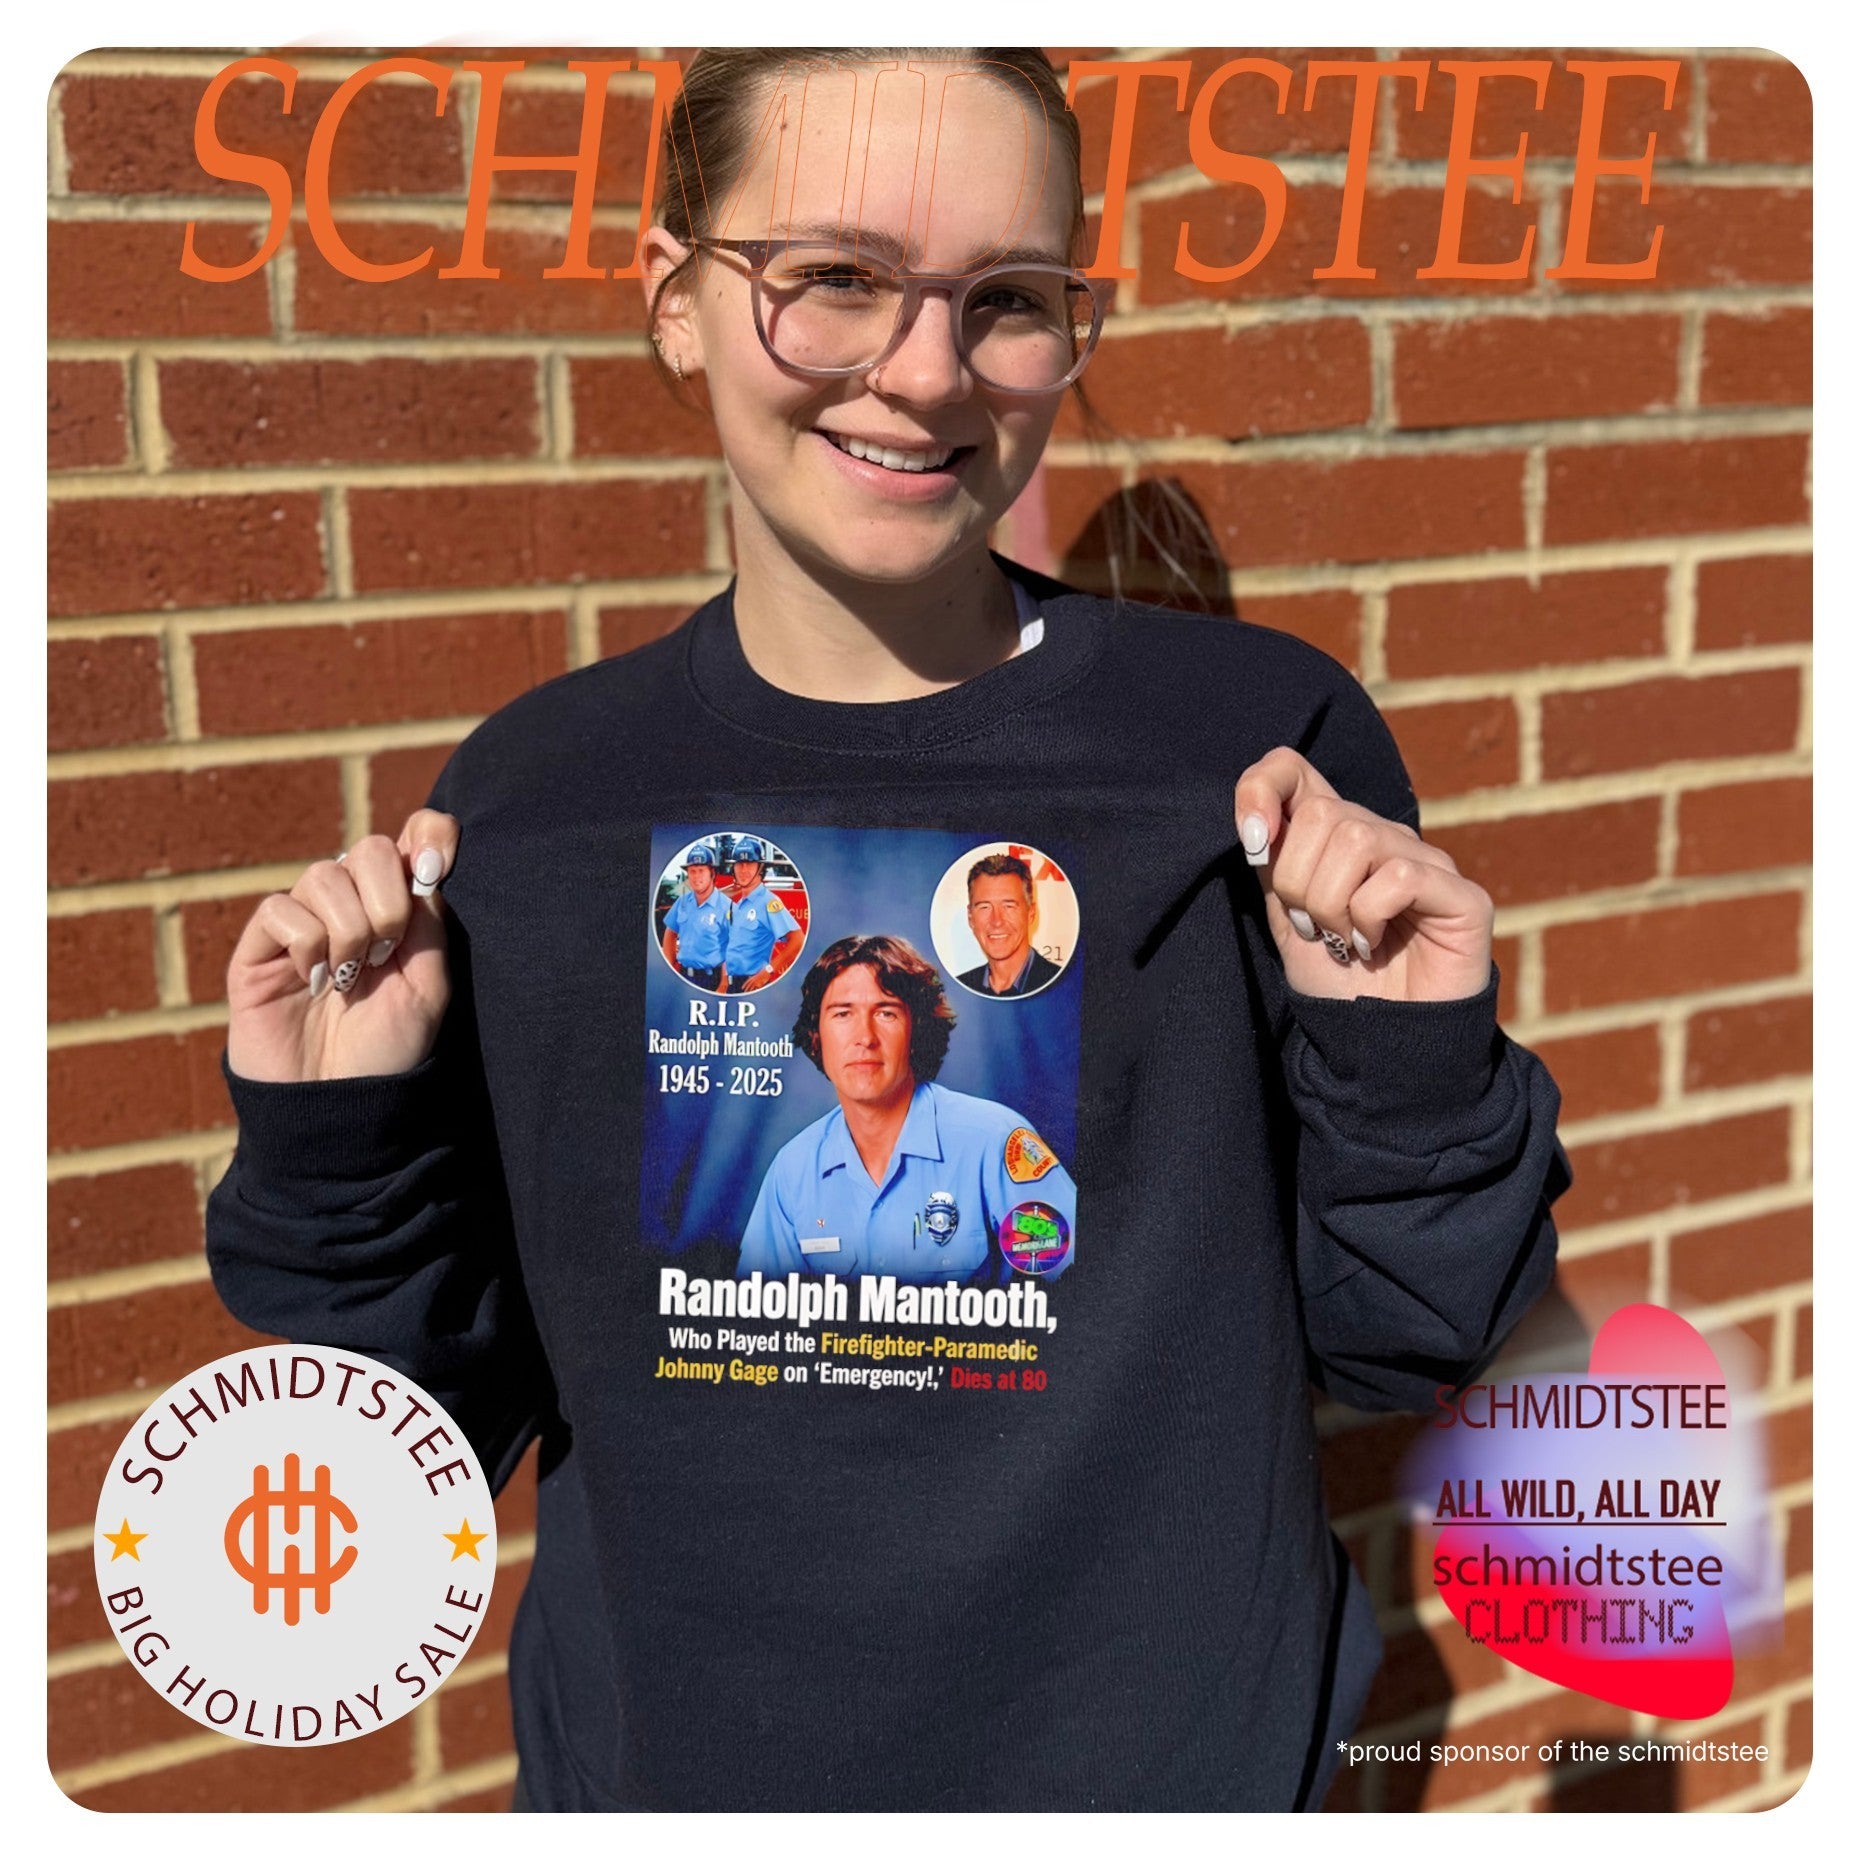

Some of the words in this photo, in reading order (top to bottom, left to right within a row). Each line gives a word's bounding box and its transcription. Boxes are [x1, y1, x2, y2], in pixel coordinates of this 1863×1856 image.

[689, 1000, 759, 1027] R.I.P.
[649, 1029, 719, 1060] Randolph
[723, 1032, 793, 1057] Mantooth
[659, 1064, 710, 1094] 1945
[730, 1067, 783, 1096] 2025
[659, 1267, 848, 1328] Randolph
[859, 1274, 1058, 1334] Mantooth,
[668, 1326, 712, 1350] Who
[717, 1329, 780, 1355] Played
[785, 1331, 816, 1353] the
[821, 1332, 1038, 1361] Firefighter-Paramedic
[655, 1356, 724, 1384] Johnny
[729, 1358, 779, 1385] Gage
[784, 1365, 807, 1383] on
[951, 1366, 992, 1388] Dies
[997, 1369, 1016, 1390] at
[1022, 1369, 1047, 1391] 80
